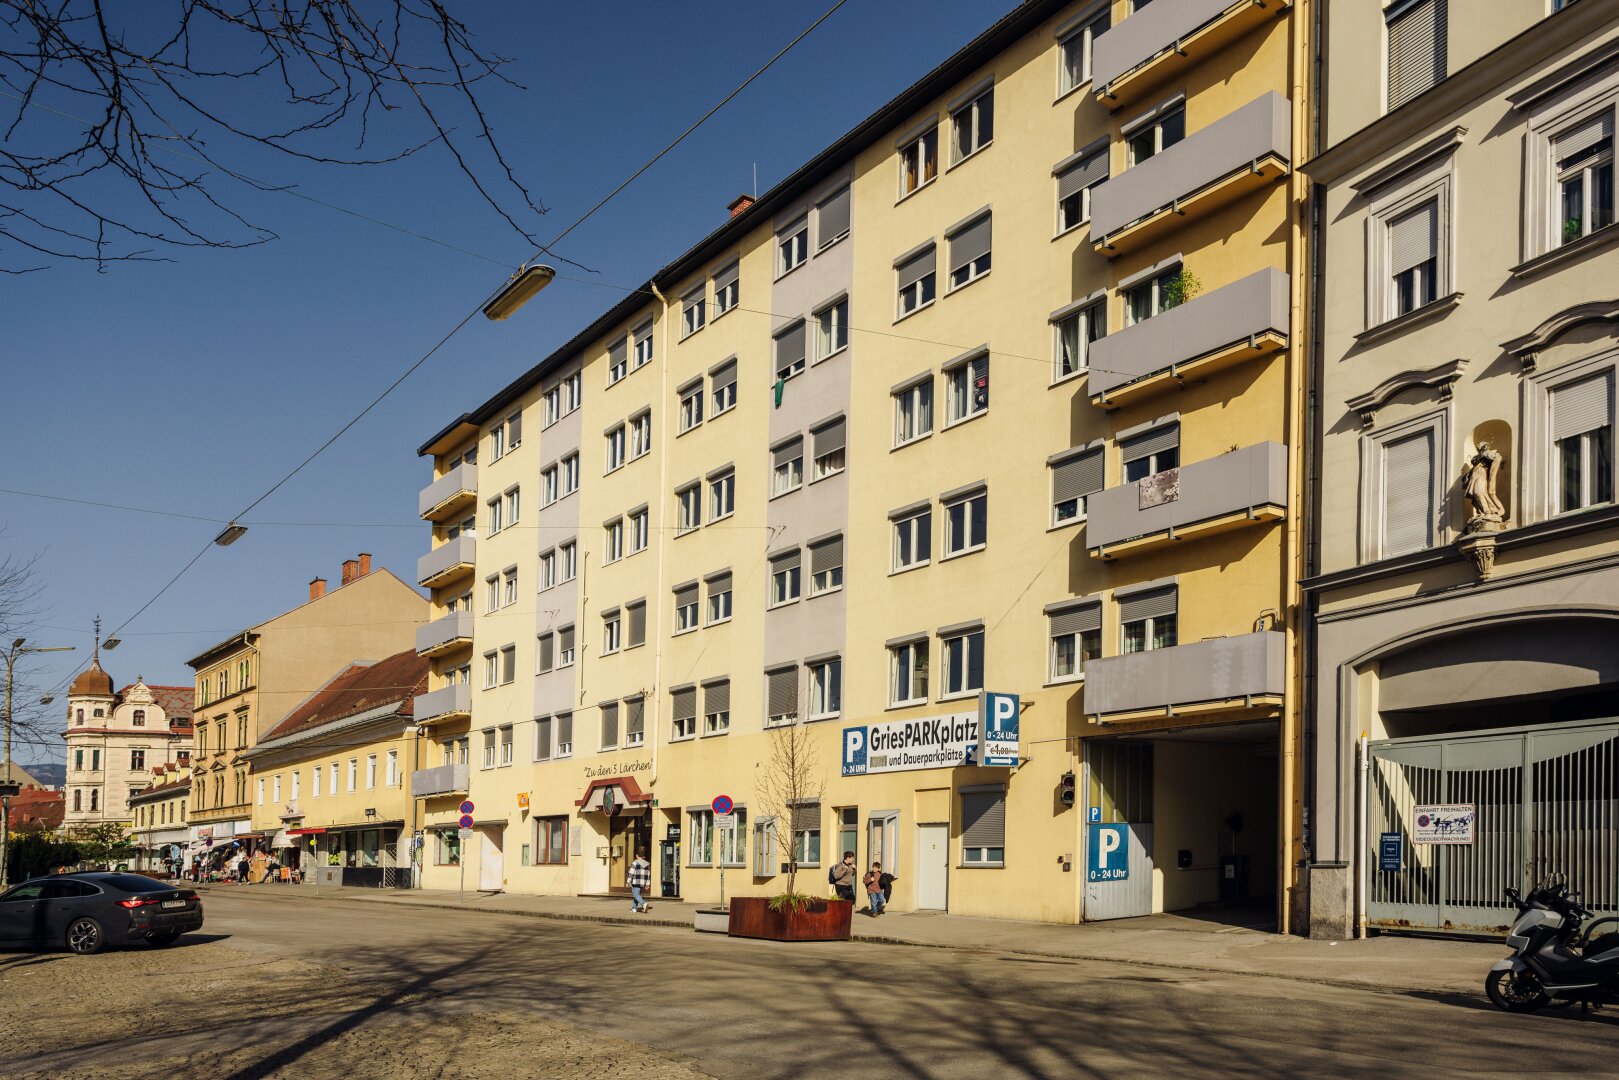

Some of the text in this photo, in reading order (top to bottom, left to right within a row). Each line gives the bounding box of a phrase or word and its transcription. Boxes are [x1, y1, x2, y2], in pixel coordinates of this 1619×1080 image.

[995, 696, 1014, 731] P
[870, 716, 978, 751] GriesPARKplatz
[987, 731, 992, 739] 0
[996, 731, 1005, 739] 24
[1006, 731, 1018, 740] Uhr
[846, 731, 863, 762] P
[889, 753, 902, 766] und
[903, 748, 963, 766] Dauerparkplätze
[597, 765, 612, 776] den
[613, 763, 618, 775] 5
[843, 765, 847, 774] 0
[849, 765, 855, 773] 24
[856, 764, 866, 773] UHR
[1091, 807, 1098, 820] P
[1099, 829, 1120, 868] P
[1091, 870, 1096, 879] 0
[1102, 870, 1111, 879] 24
[1113, 868, 1127, 878] Uhr
